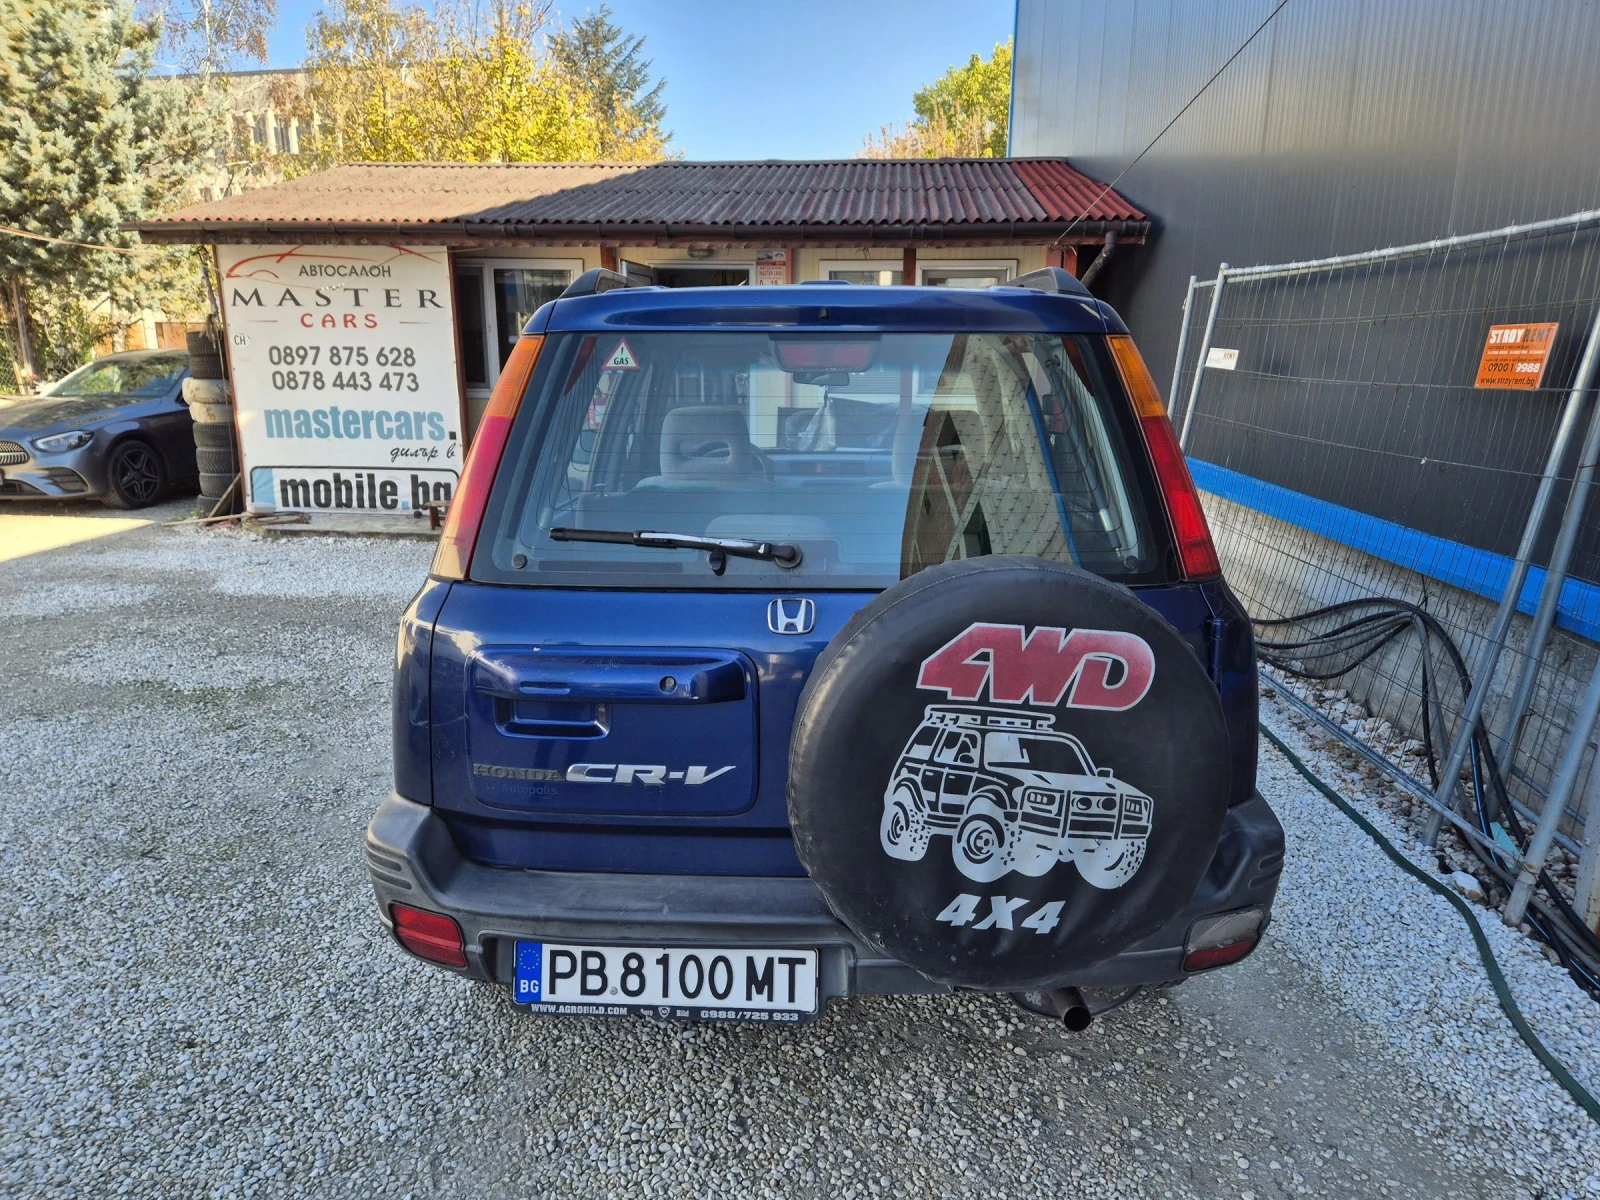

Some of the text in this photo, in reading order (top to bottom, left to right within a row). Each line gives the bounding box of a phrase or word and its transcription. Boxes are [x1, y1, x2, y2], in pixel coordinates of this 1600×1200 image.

[298, 264, 392, 278] АВТОСАЛОН
[231, 287, 446, 309] MASTER
[300, 313, 378, 329] CARS
[269, 345, 416, 367] 0897 875 628
[613, 357, 629, 365] GAS
[272, 371, 419, 392] 0878 443 473
[1480, 377, 1536, 387] www.stroyrent.bg
[915, 622, 1156, 711] 4WD
[473, 763, 566, 781] HONDA
[566, 763, 737, 785] CR-V
[548, 949, 807, 1003] PB 8100 MT
[519, 979, 539, 994] BG
[531, 1004, 628, 1016] WWW.AGROBILD.COM
